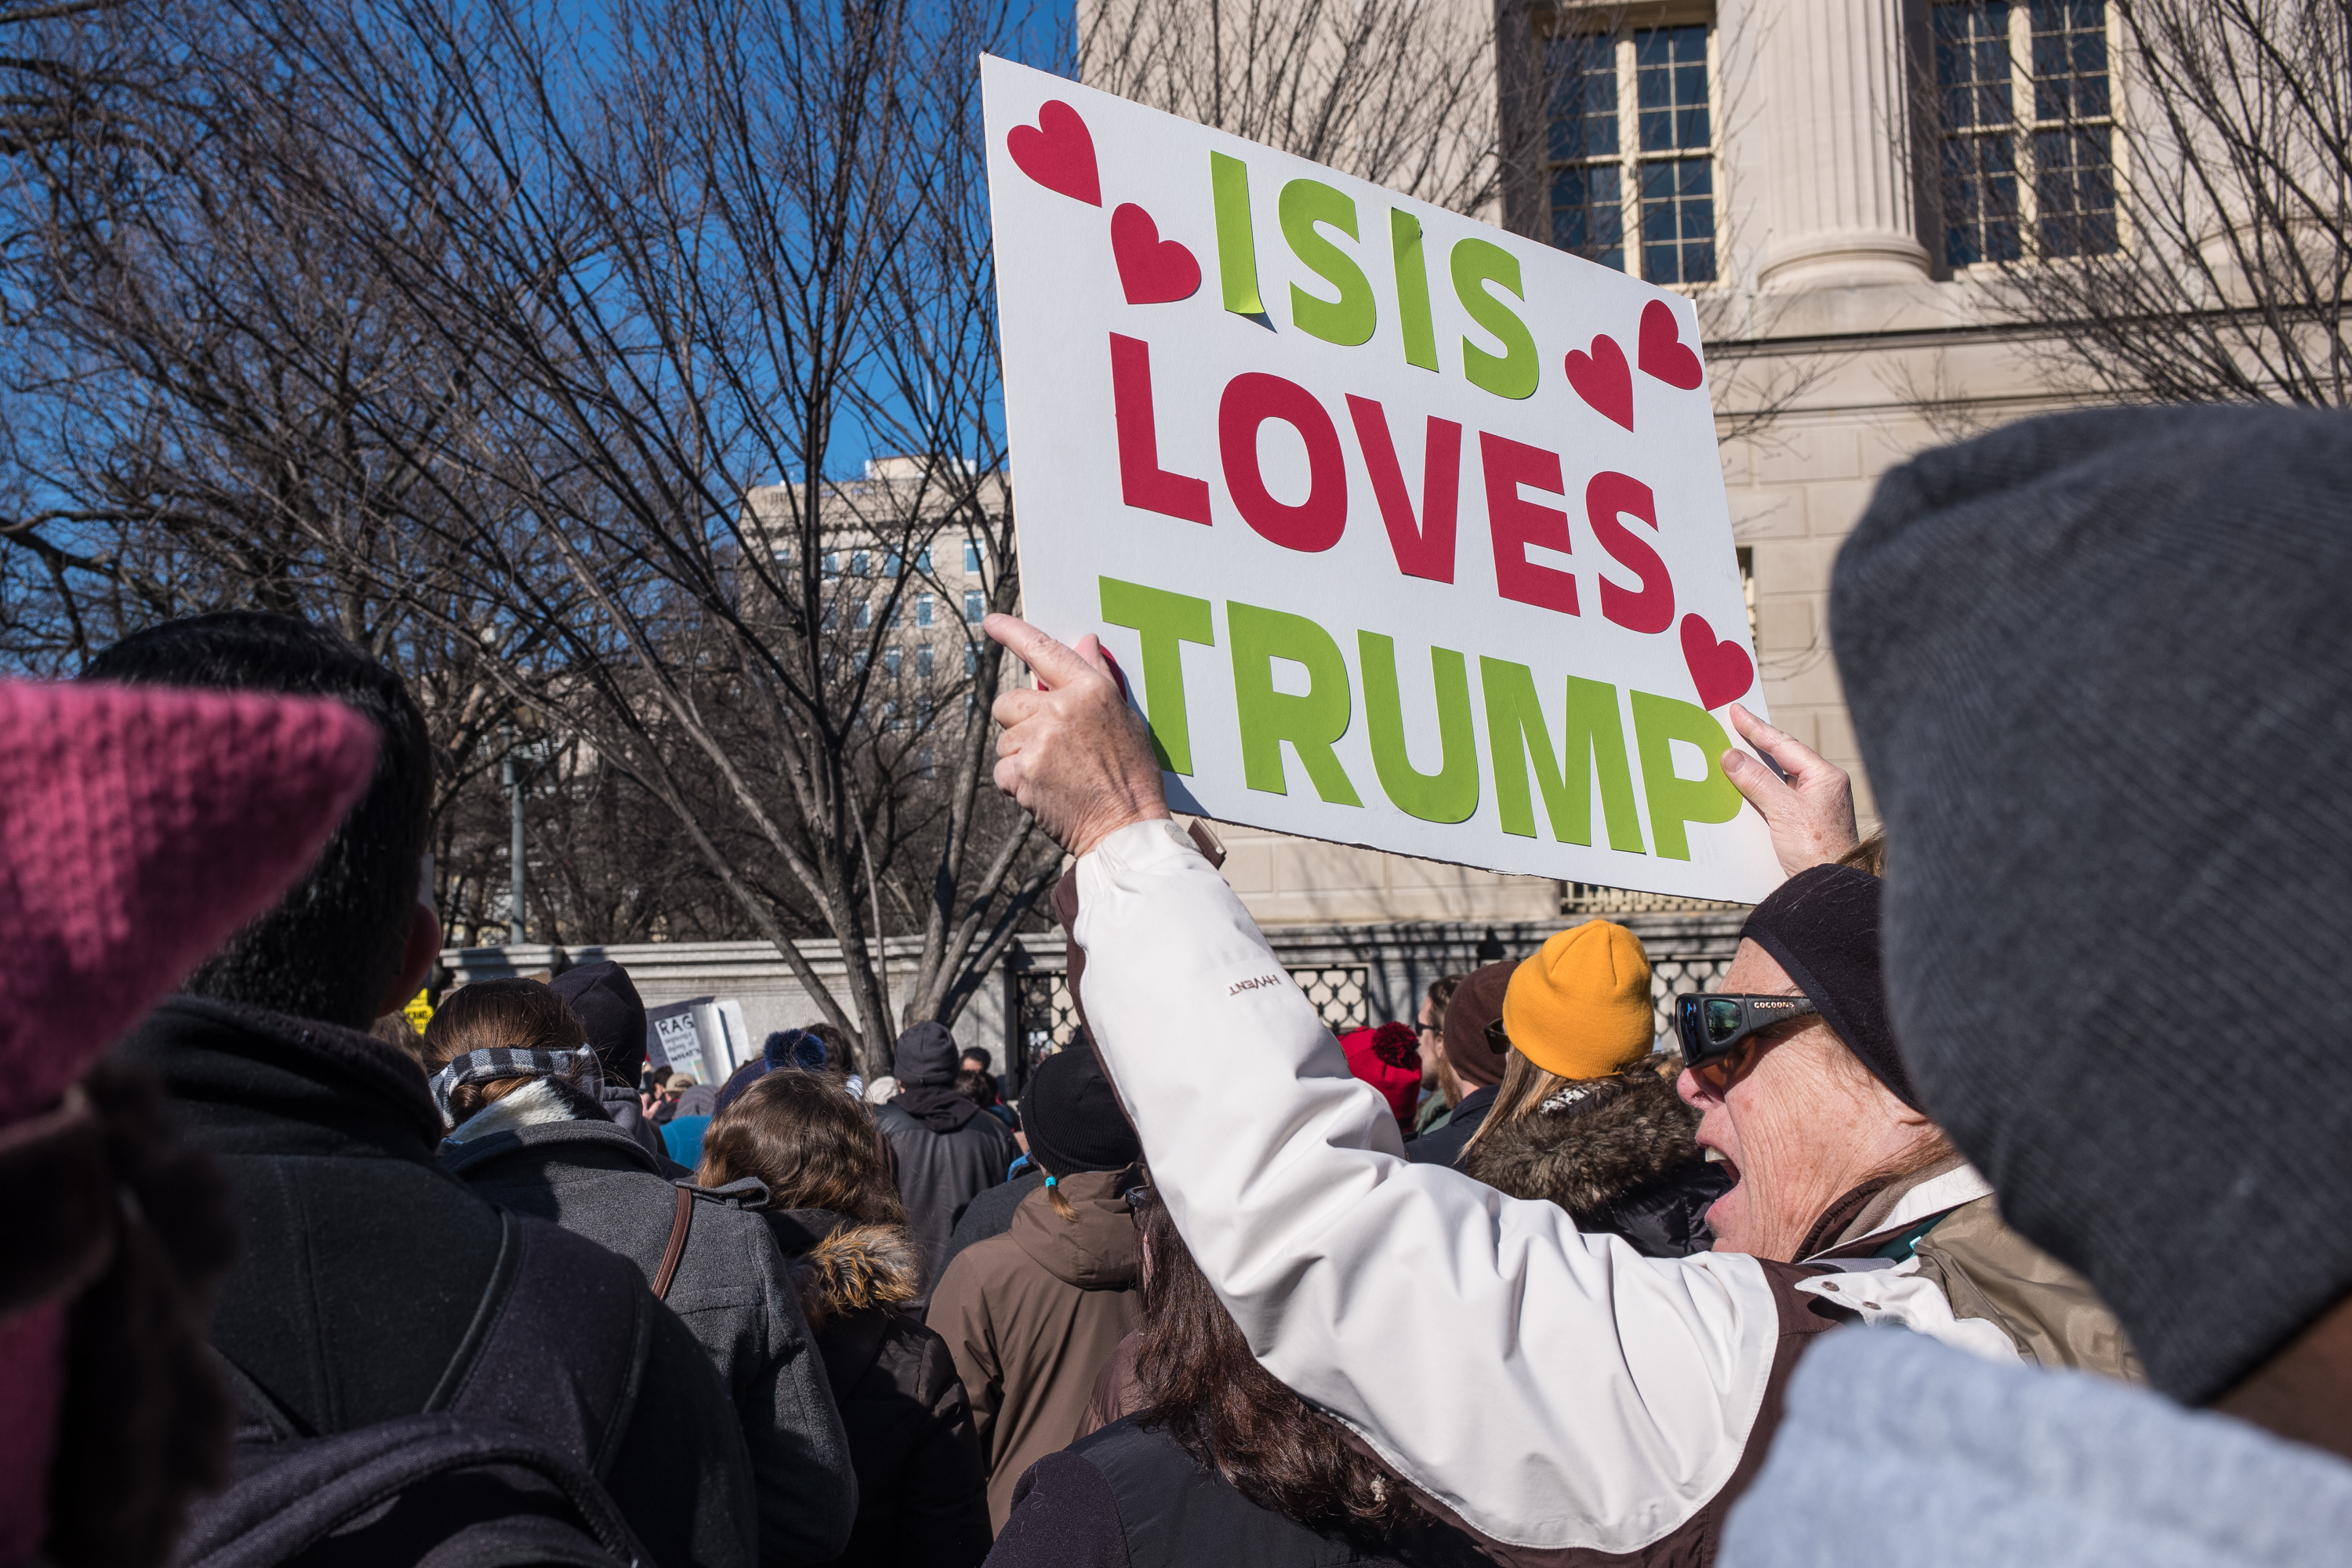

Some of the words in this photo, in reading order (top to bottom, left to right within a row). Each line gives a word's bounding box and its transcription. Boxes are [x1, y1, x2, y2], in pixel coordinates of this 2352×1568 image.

[1210, 151, 1538, 399] ISIS
[1109, 332, 1675, 633] LOVES
[1099, 575, 1743, 861] TRUMP
[1229, 975, 1281, 996] HYVENT
